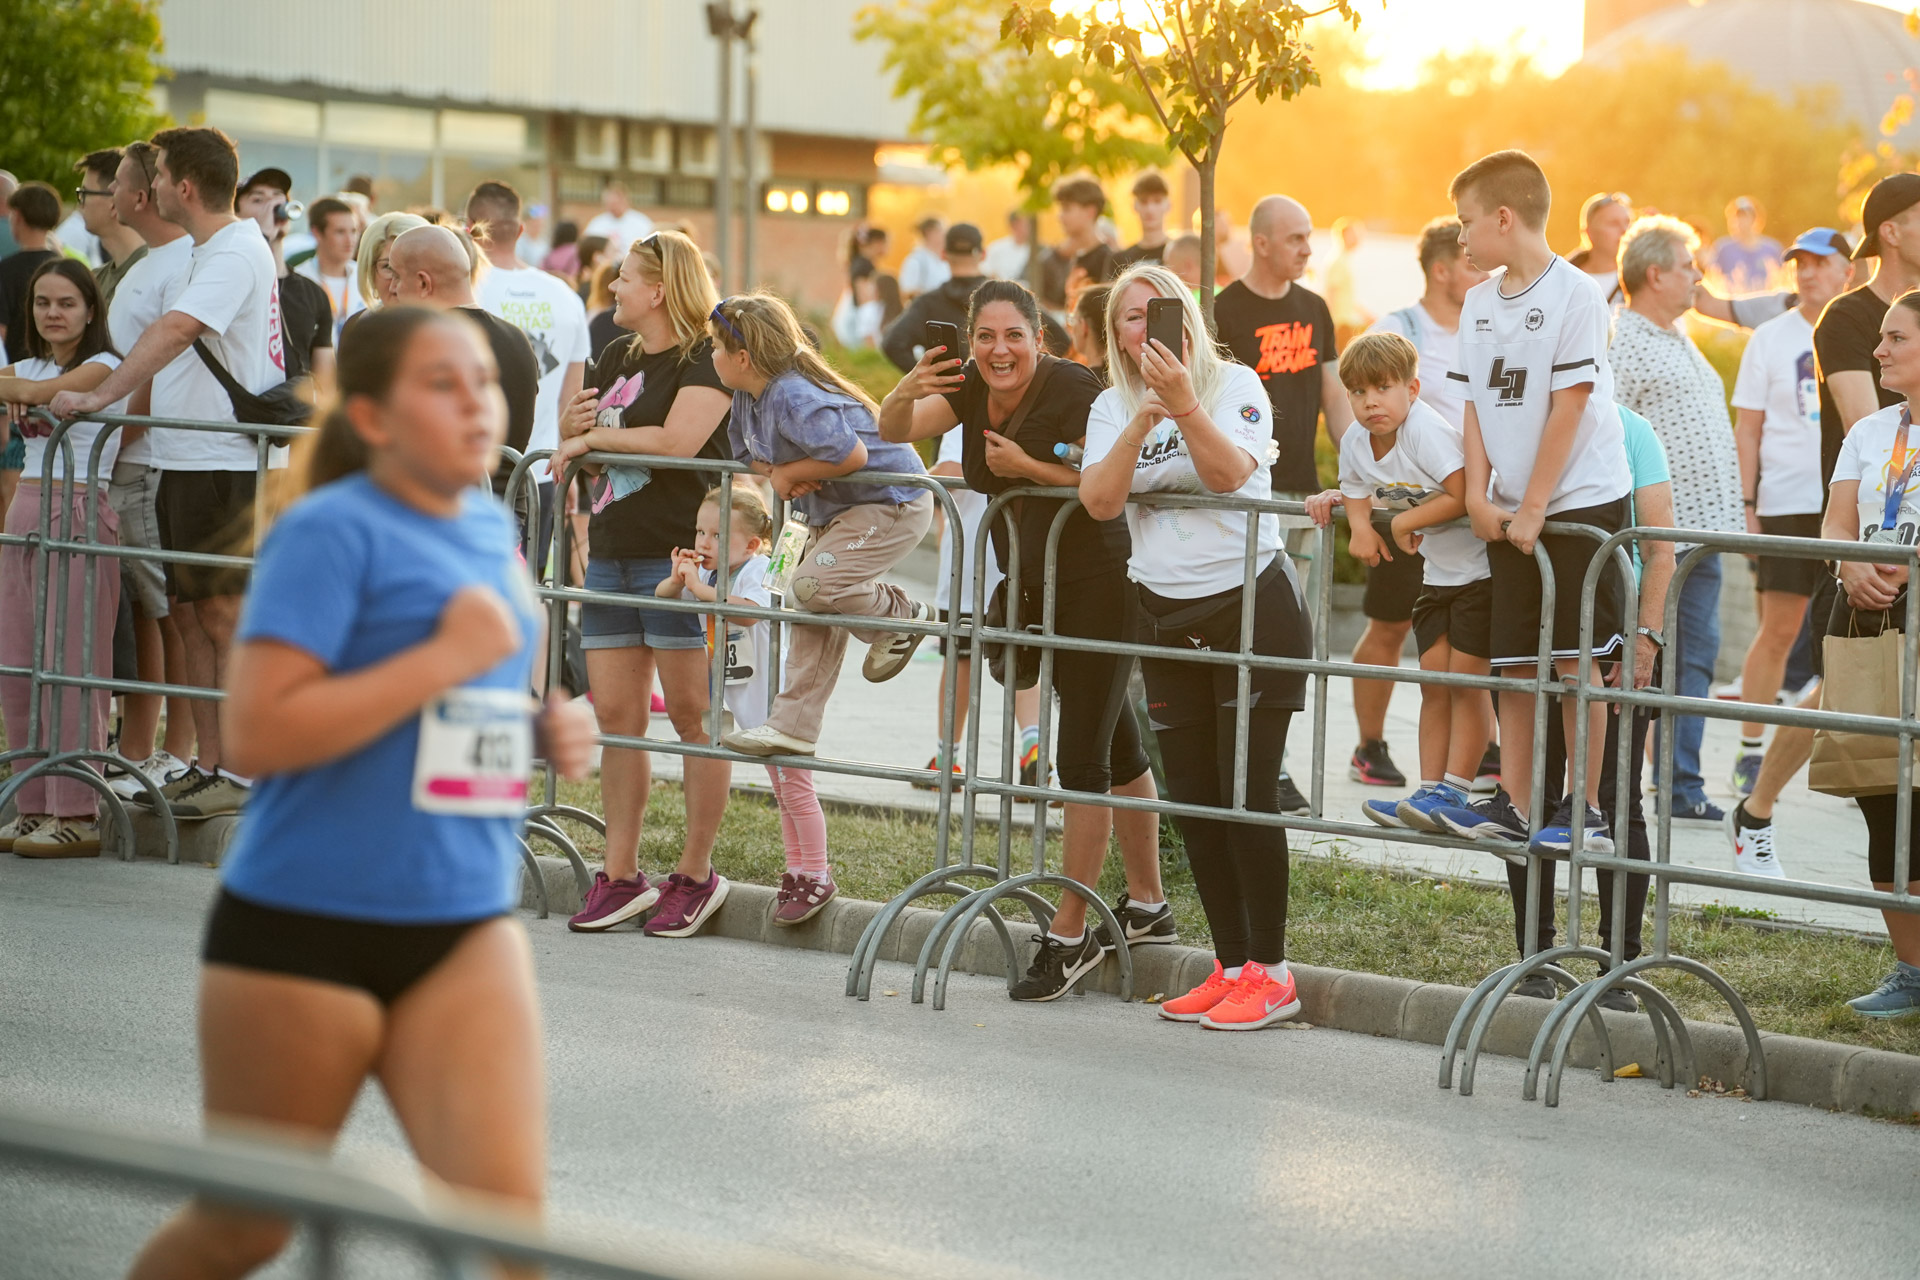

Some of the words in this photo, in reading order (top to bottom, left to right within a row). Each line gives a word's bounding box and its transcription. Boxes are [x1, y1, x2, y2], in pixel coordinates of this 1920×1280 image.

[501, 302, 551, 315] KOLOR
[1255, 321, 1313, 352] TRAIN
[1487, 356, 1528, 402] LA
